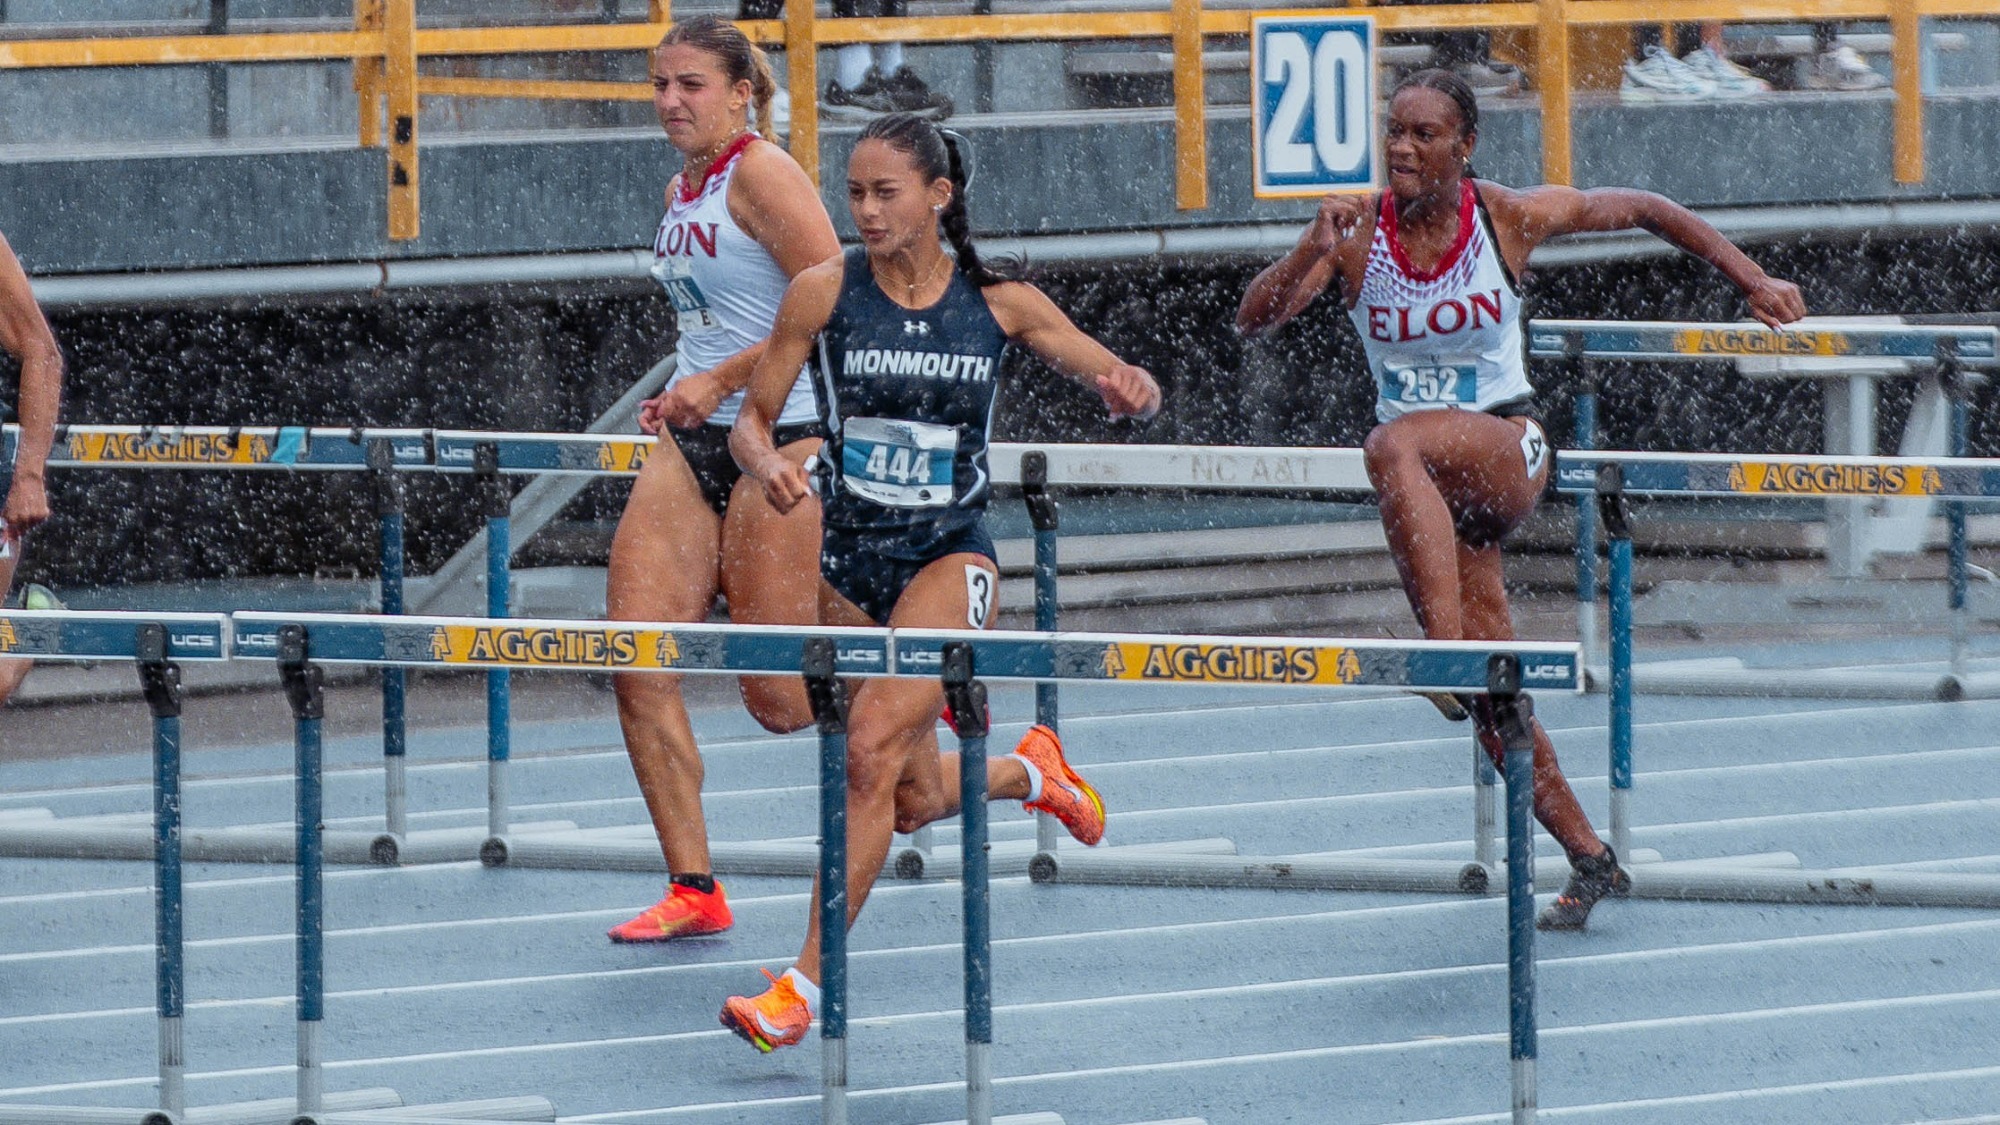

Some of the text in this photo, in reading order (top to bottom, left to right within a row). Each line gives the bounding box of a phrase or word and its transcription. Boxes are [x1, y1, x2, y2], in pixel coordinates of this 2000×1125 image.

[1264, 30, 1367, 173] 20
[1368, 288, 1502, 343] ELON
[1699, 329, 1817, 353] AGGIES
[843, 350, 993, 382] MONMOUTH
[1397, 367, 1459, 401] 252
[101, 432, 235, 463] AGGIES
[865, 444, 931, 484] 444
[1560, 469, 1596, 481] UCS
[1762, 462, 1906, 493] AGGIES
[972, 572, 989, 626] 3
[171, 633, 215, 647] UCS
[236, 633, 277, 646] UCS
[467, 627, 638, 665] AGGIES
[837, 649, 882, 662] UCS
[1143, 644, 1319, 683] AGGIES
[1524, 664, 1570, 680] UCS
